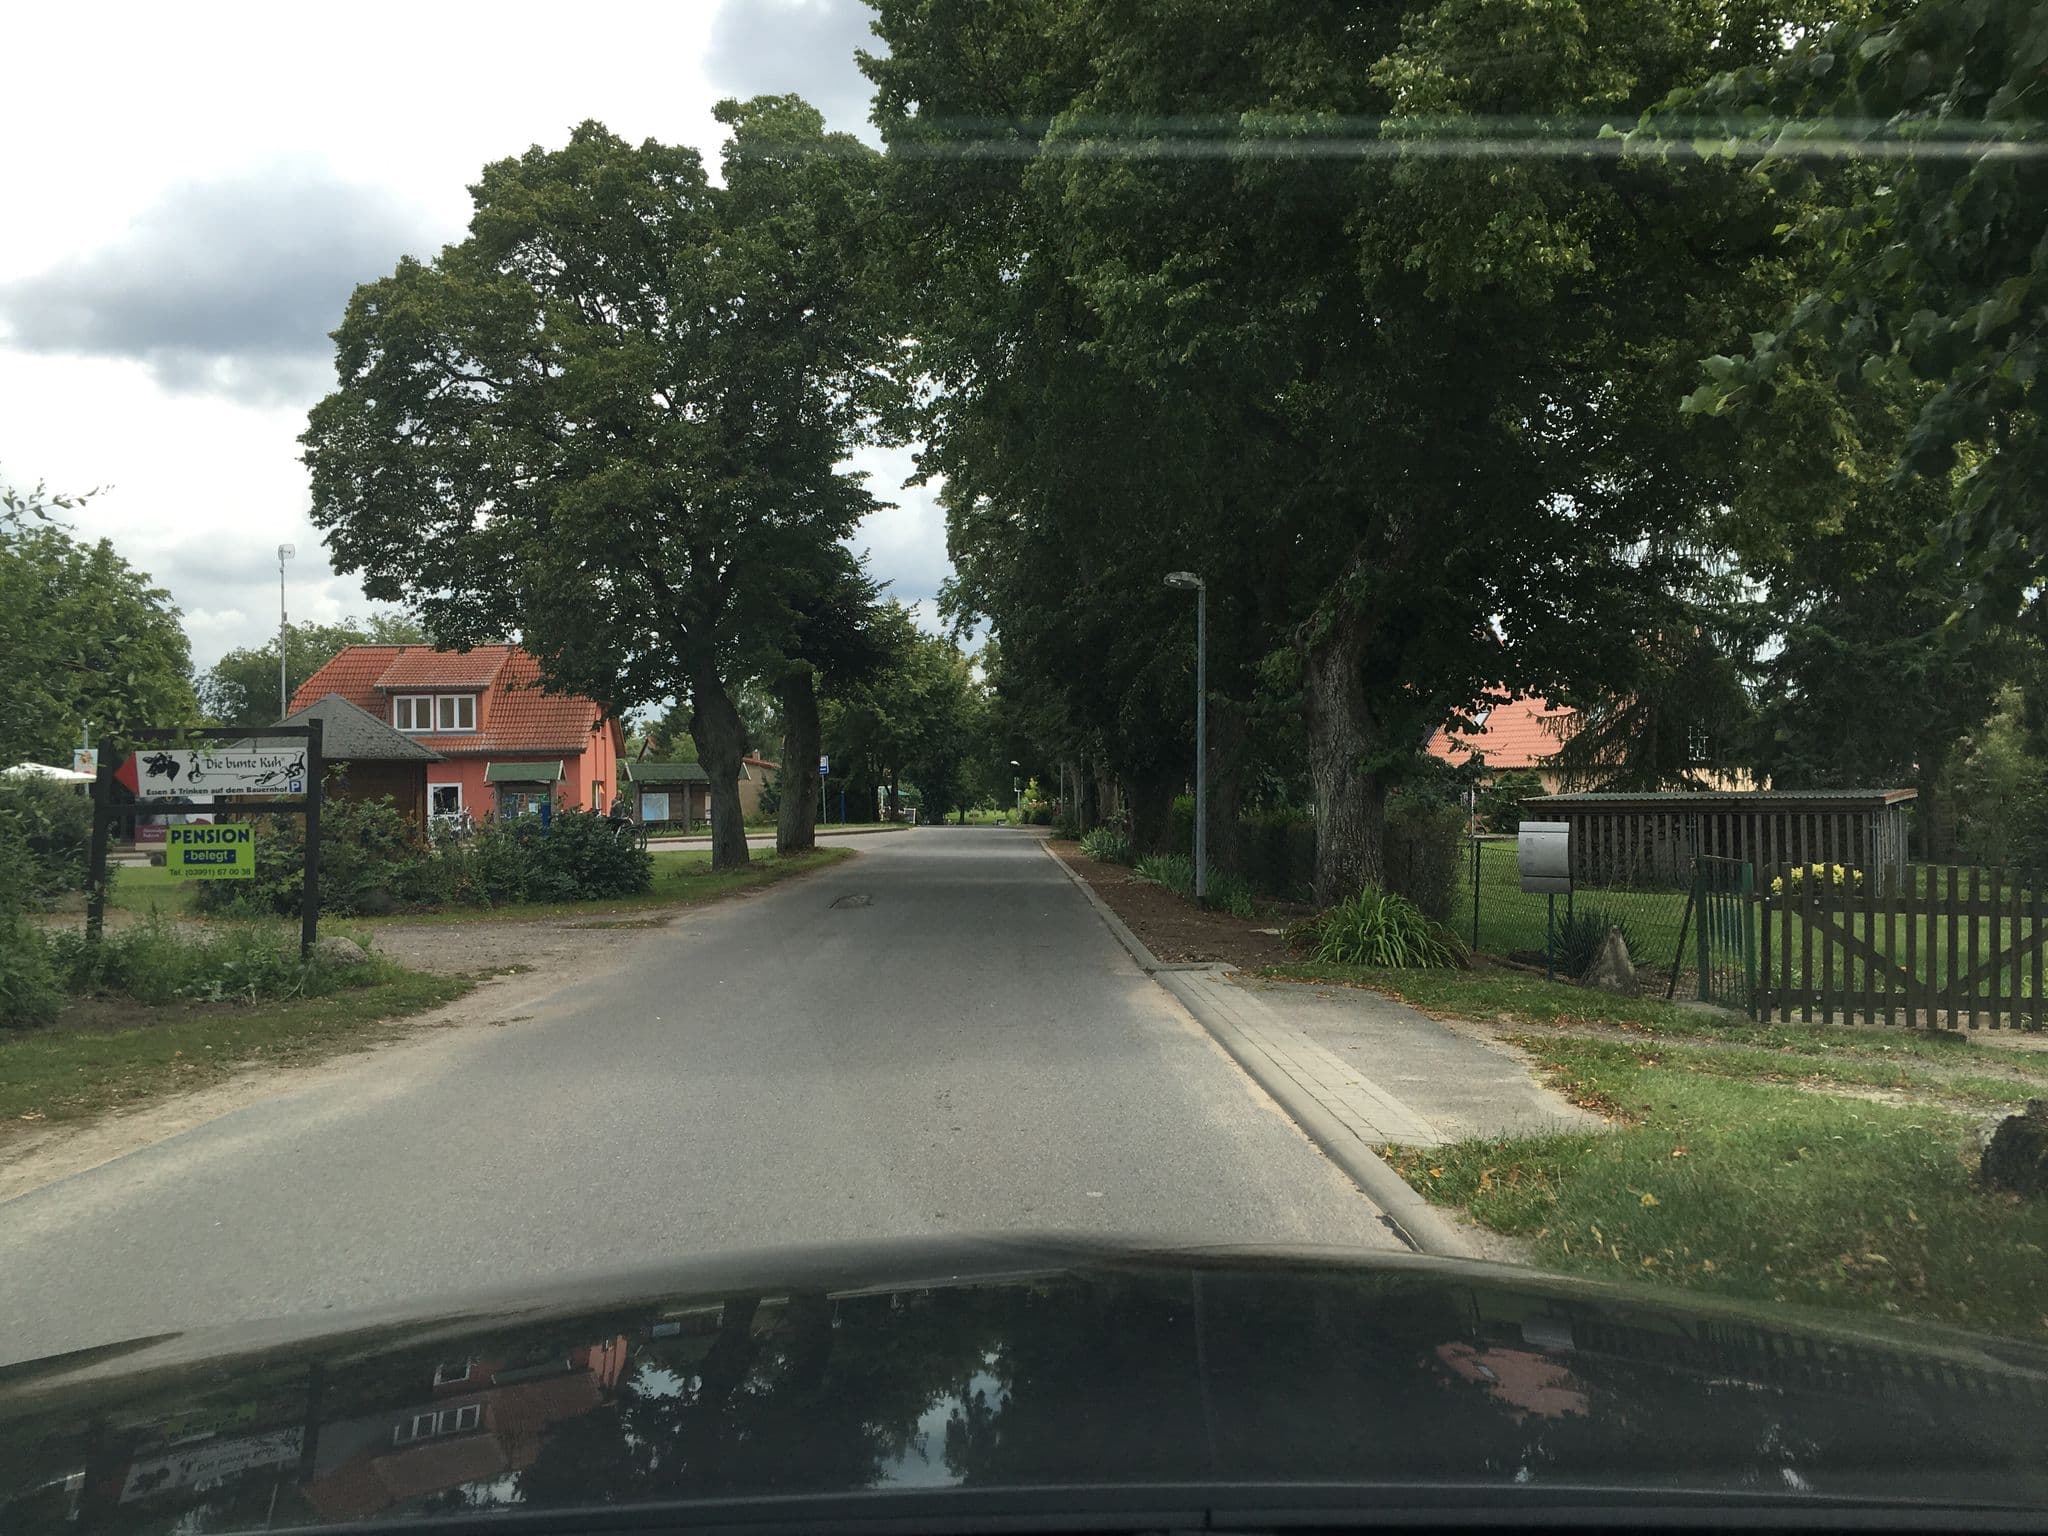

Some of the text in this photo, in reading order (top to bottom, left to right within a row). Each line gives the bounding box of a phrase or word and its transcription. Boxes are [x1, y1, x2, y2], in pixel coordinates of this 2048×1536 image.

[206, 756, 282, 769] Die bunte Kuh
[179, 787, 208, 795] Trinken
[211, 786, 223, 794] auf
[226, 786, 243, 794] dem
[171, 829, 250, 845] PENSION
[190, 850, 228, 863] belegt
